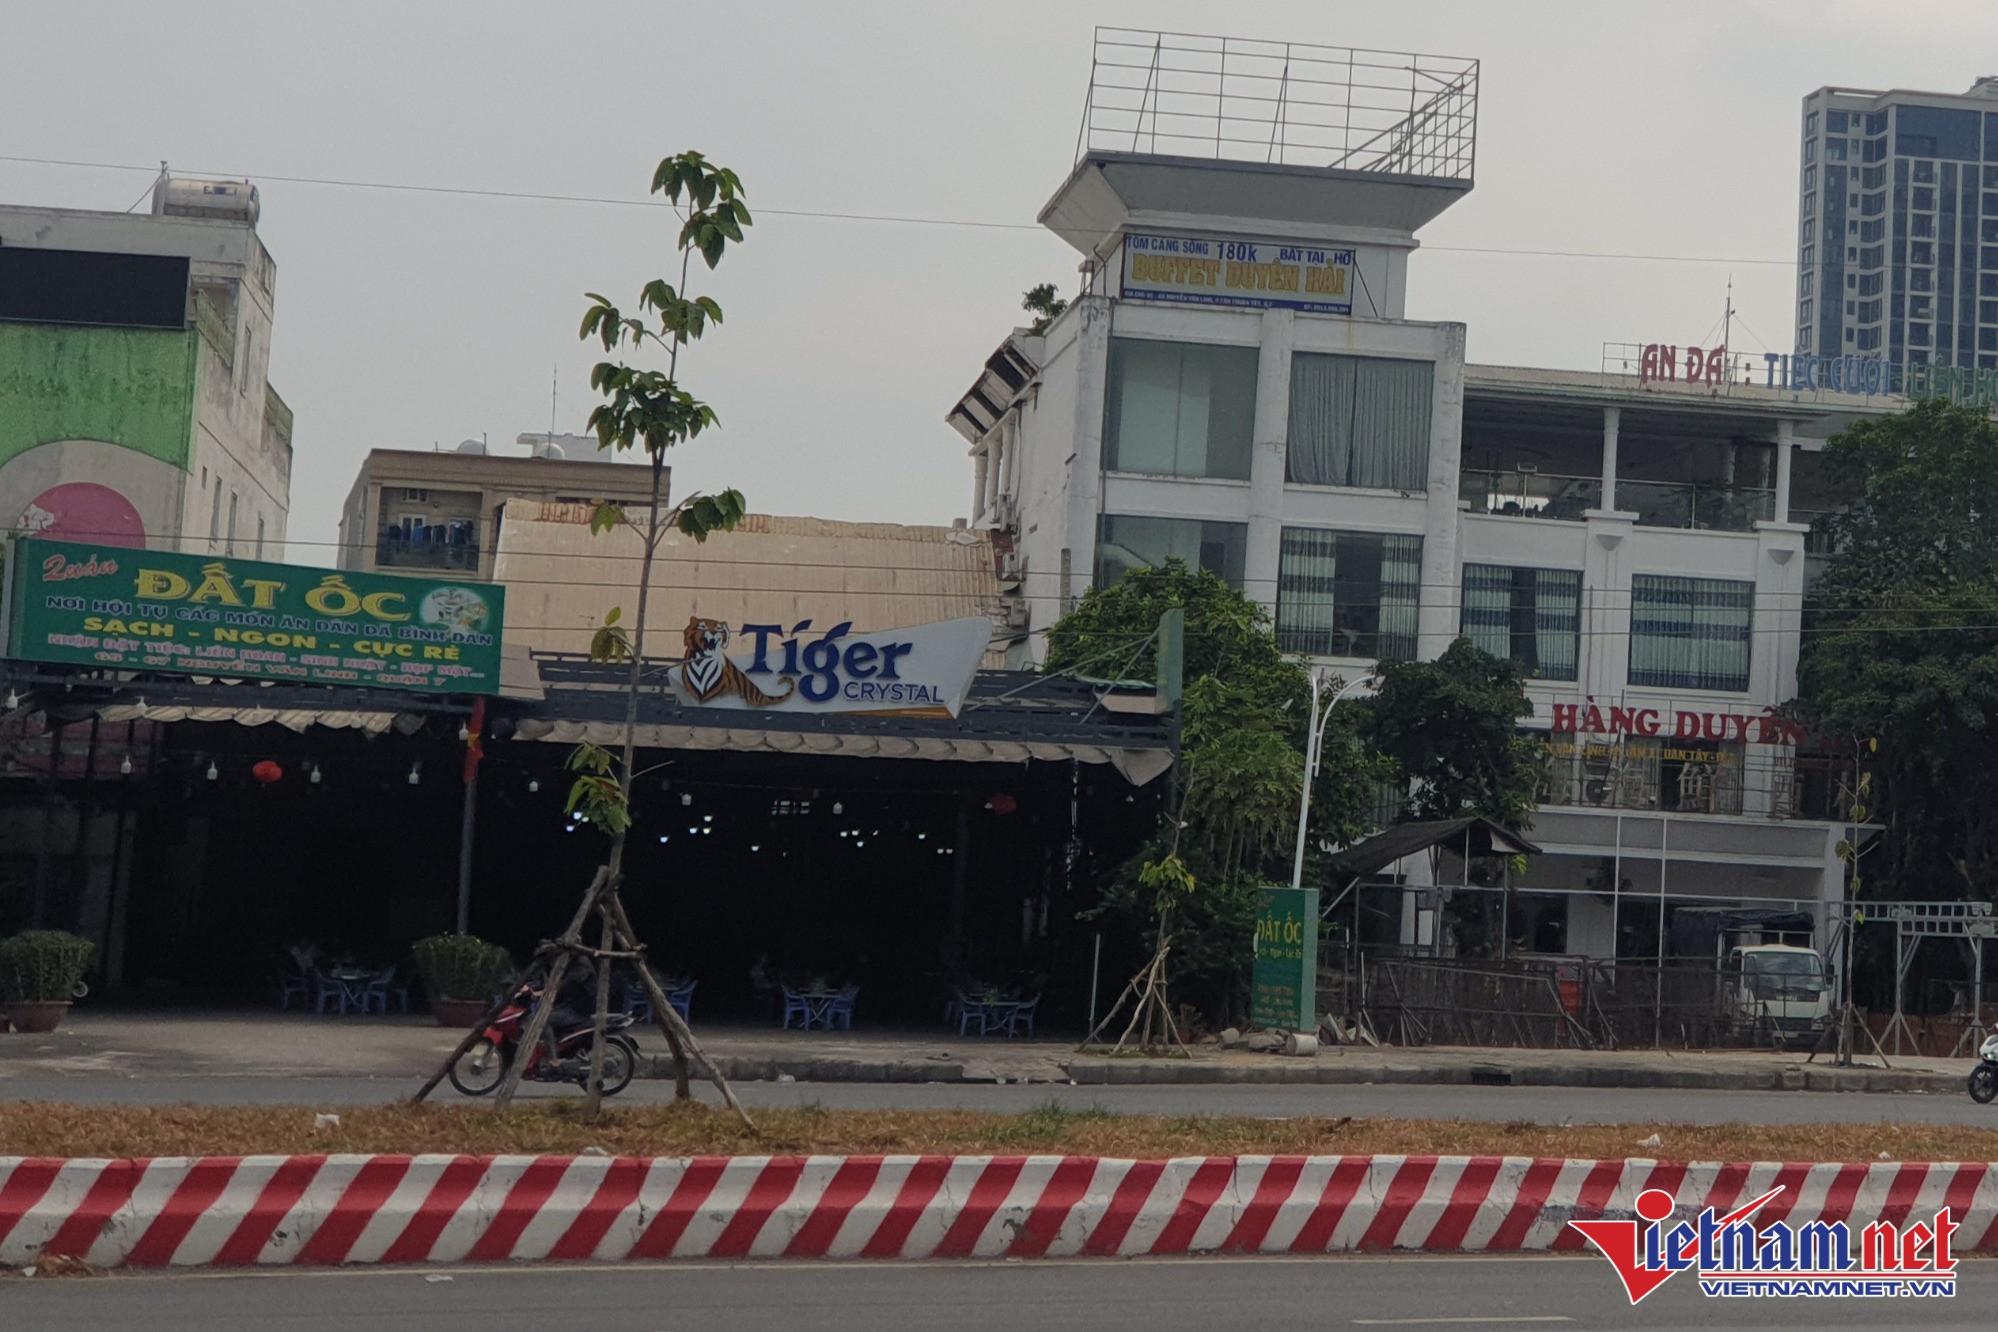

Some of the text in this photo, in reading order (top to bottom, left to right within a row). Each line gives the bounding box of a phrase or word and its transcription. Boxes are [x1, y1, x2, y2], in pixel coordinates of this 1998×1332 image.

[1131, 253, 1346, 295] BUFFET DUYÊN HẢI
[42, 553, 118, 581] Quán
[305, 575, 411, 621] ỐC
[46, 596, 86, 612] NƠI
[92, 598, 132, 618] HỘI
[138, 603, 168, 619] TỤ
[176, 606, 219, 622] CÁC
[226, 609, 274, 627] MÓN
[399, 626, 445, 642] BÌNH
[84, 617, 174, 637] SẠCH
[214, 628, 317, 649] NGON
[353, 639, 412, 658] CỰC
[177, 657, 261, 673] NGUYỄN
[266, 664, 307, 676] VĂN
[313, 668, 358, 680] LINH
[376, 671, 428, 686] QUẬN
[433, 677, 446, 686] 7
[300, 653, 339, 667] SINH
[739, 619, 914, 702] Tiger
[843, 681, 945, 703] CRYSTAL
[1553, 695, 1661, 737] HÀNG
[1674, 705, 1806, 746] DUYÊN
